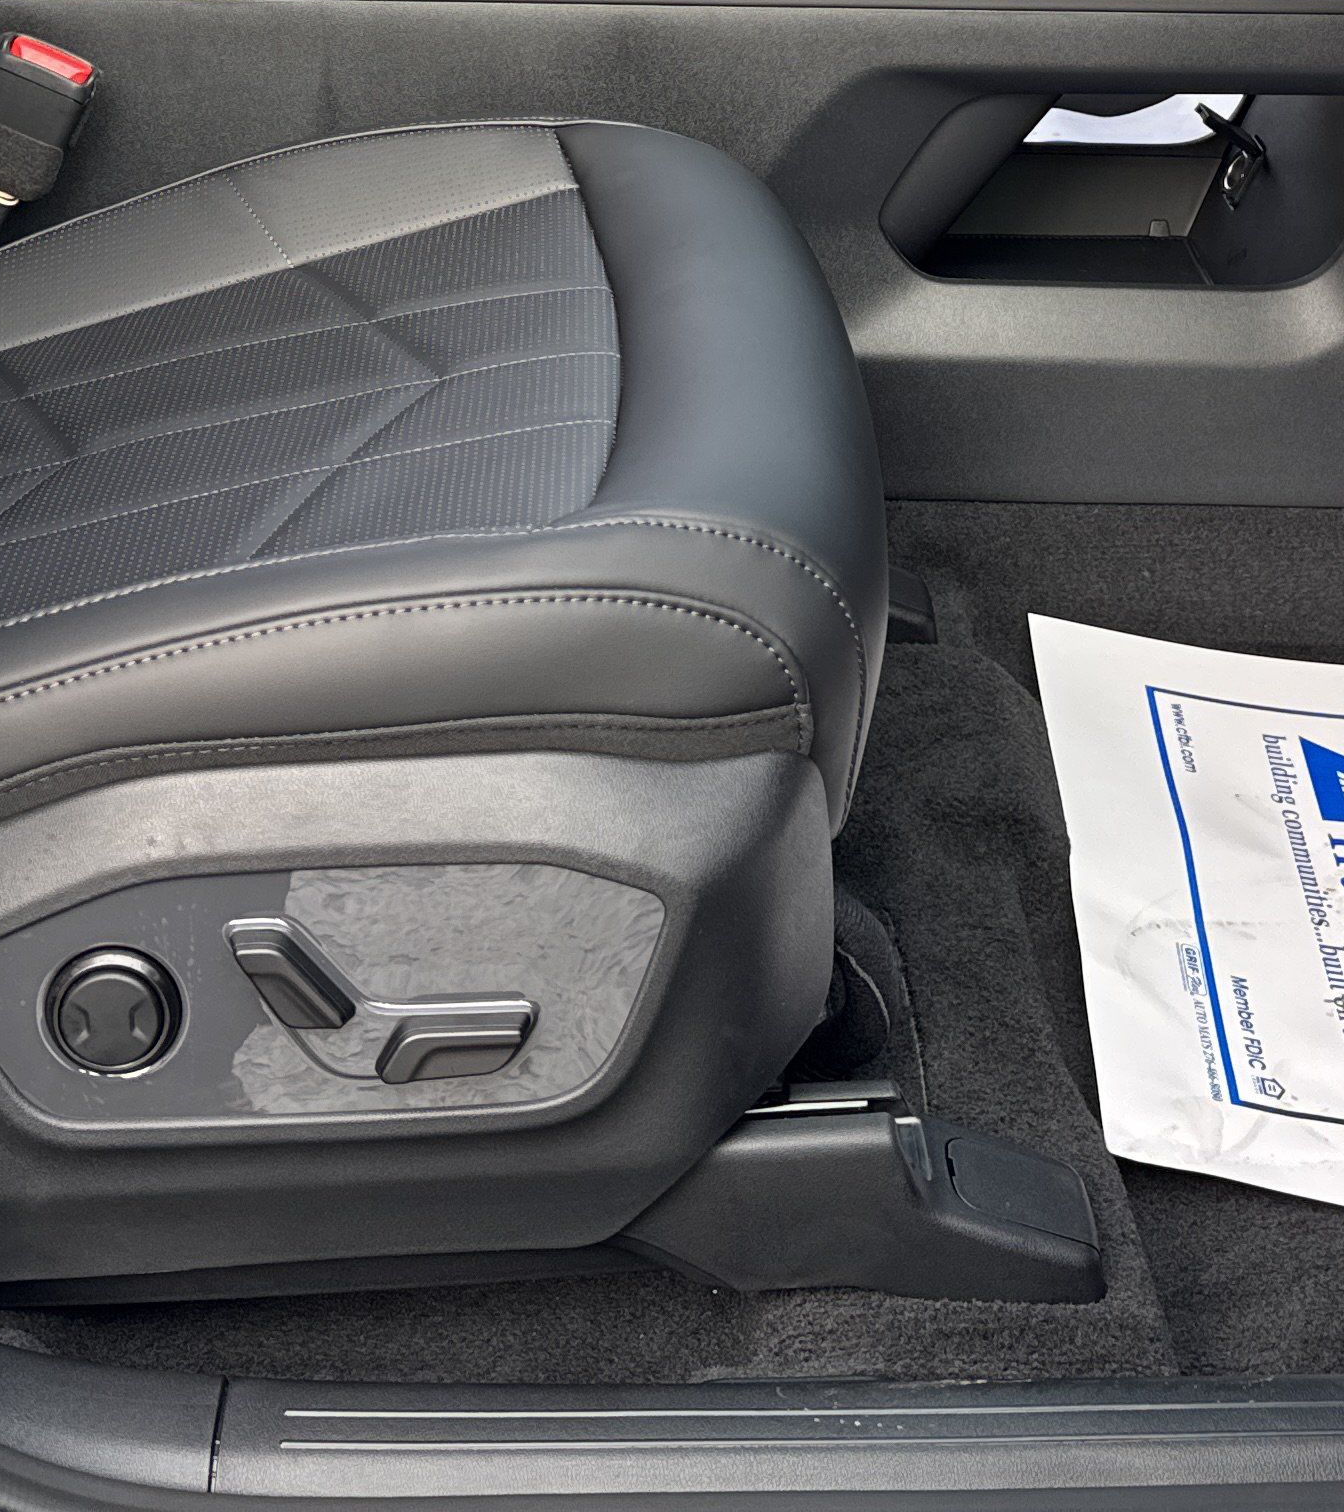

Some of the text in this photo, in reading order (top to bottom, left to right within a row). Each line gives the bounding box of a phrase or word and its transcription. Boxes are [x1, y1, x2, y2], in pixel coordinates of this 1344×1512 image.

[1171, 703, 1197, 773] www.ctbi.com
[1262, 733, 1296, 806] building
[1194, 999, 1207, 1025] AUTO
[1199, 1026, 1213, 1050] MATS
[1230, 975, 1255, 1035] Member
[1243, 1036, 1266, 1070] FDIC
